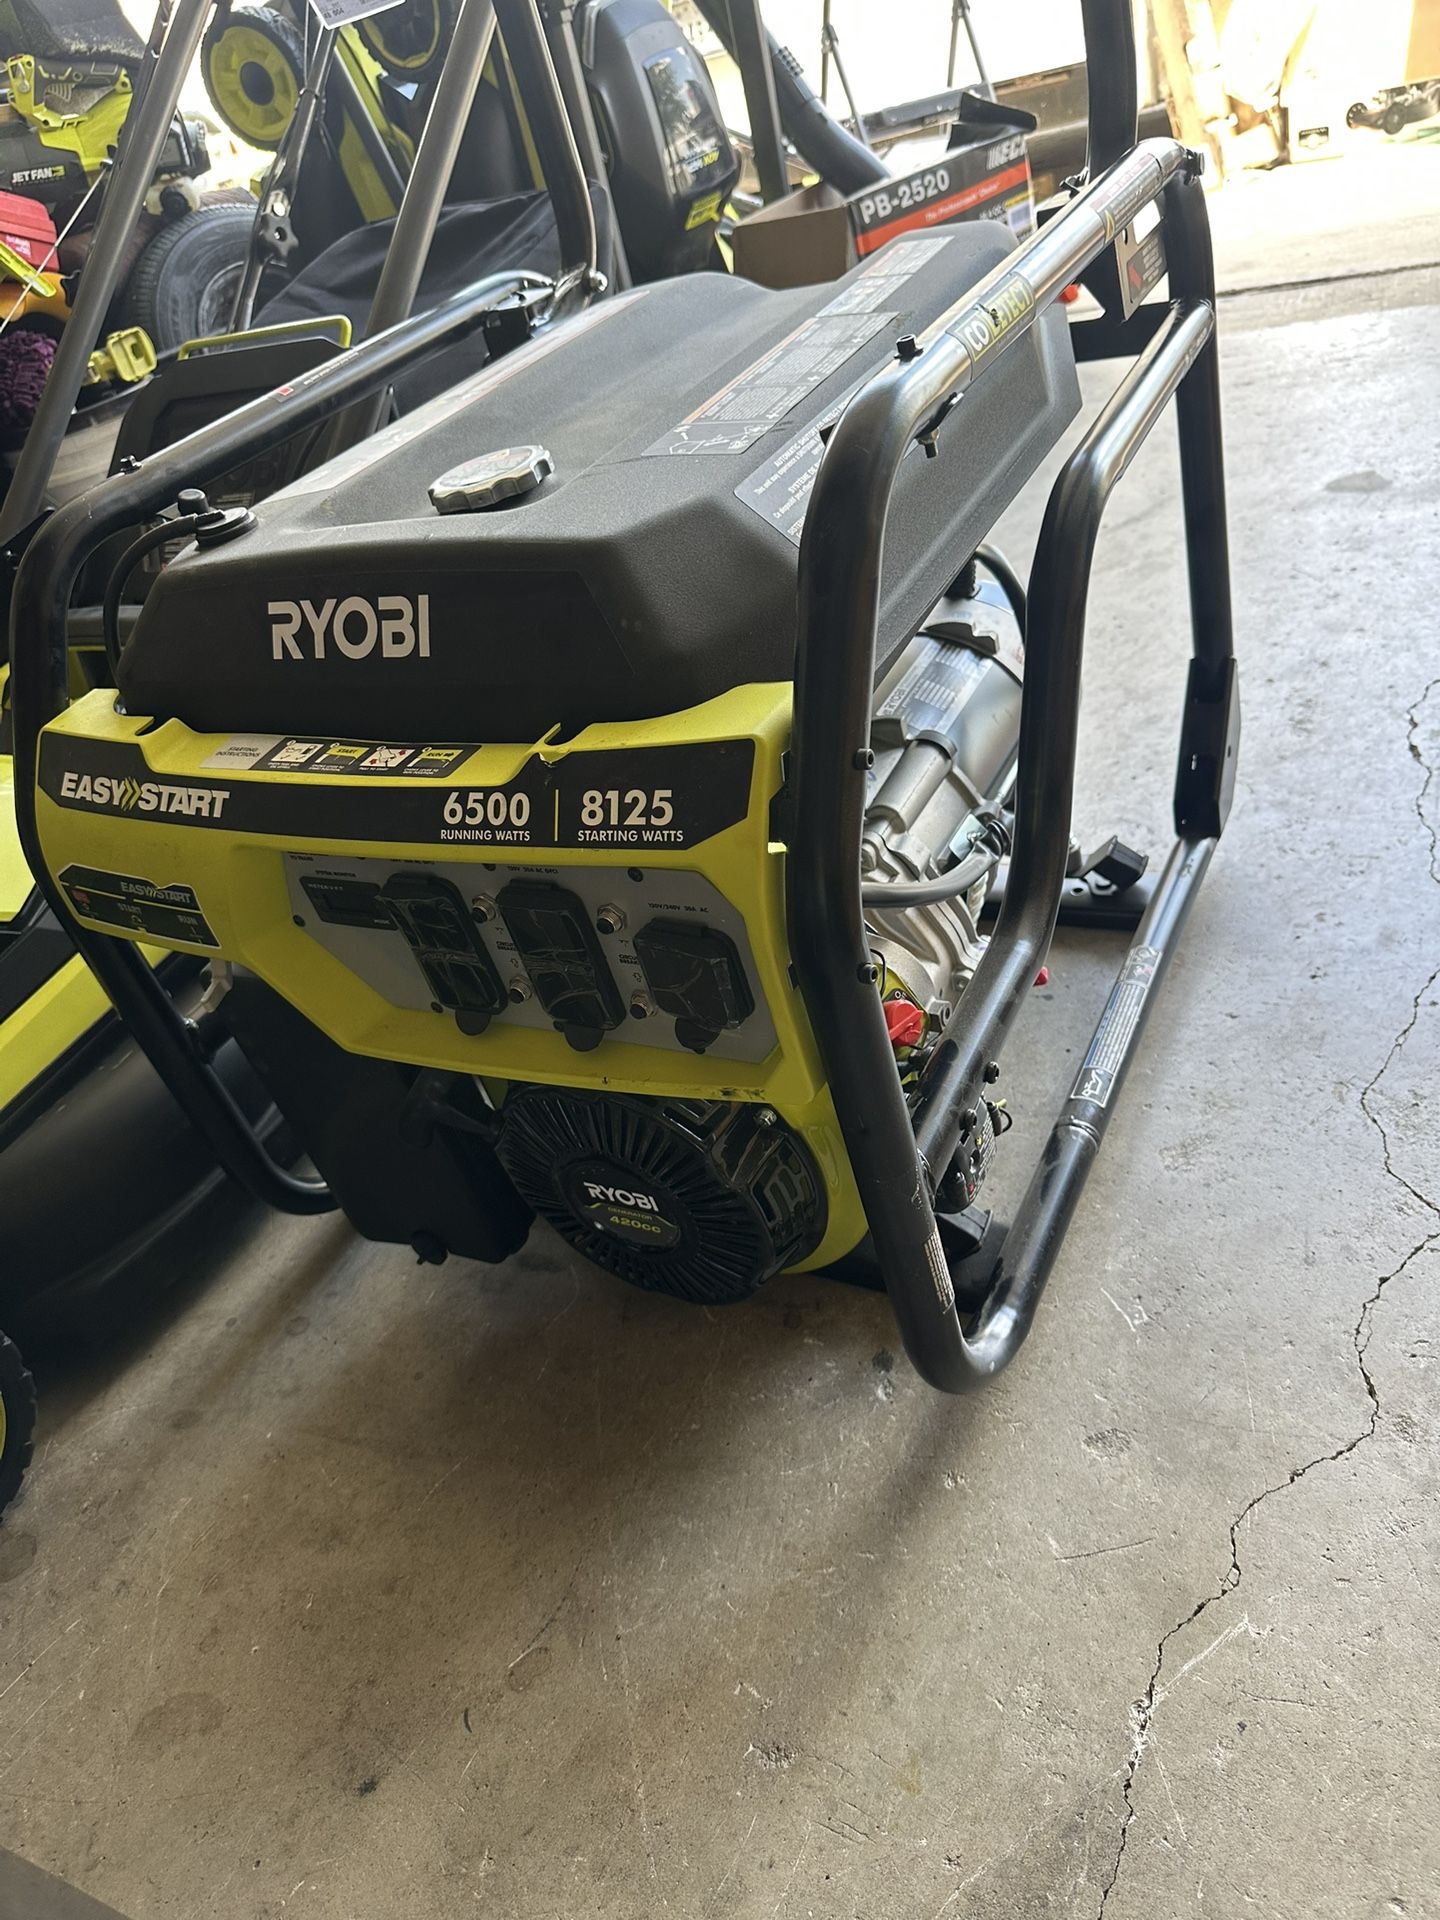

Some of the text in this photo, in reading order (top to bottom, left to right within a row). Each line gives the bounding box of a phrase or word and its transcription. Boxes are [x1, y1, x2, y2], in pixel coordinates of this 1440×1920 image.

[12, 170, 30, 183] JET
[30, 166, 53, 181] FAN
[860, 169, 950, 224] PB-2520
[964, 320, 990, 351] CO
[268, 594, 430, 660] RYOBI
[61, 771, 230, 818] EASY START
[443, 789, 673, 827] 6500 8125
[440, 829, 530, 842] RUNNING WATTS
[577, 829, 684, 842] STARTING WATTS
[120, 881, 192, 903] EASY START
[583, 1181, 659, 1212] RYOBI
